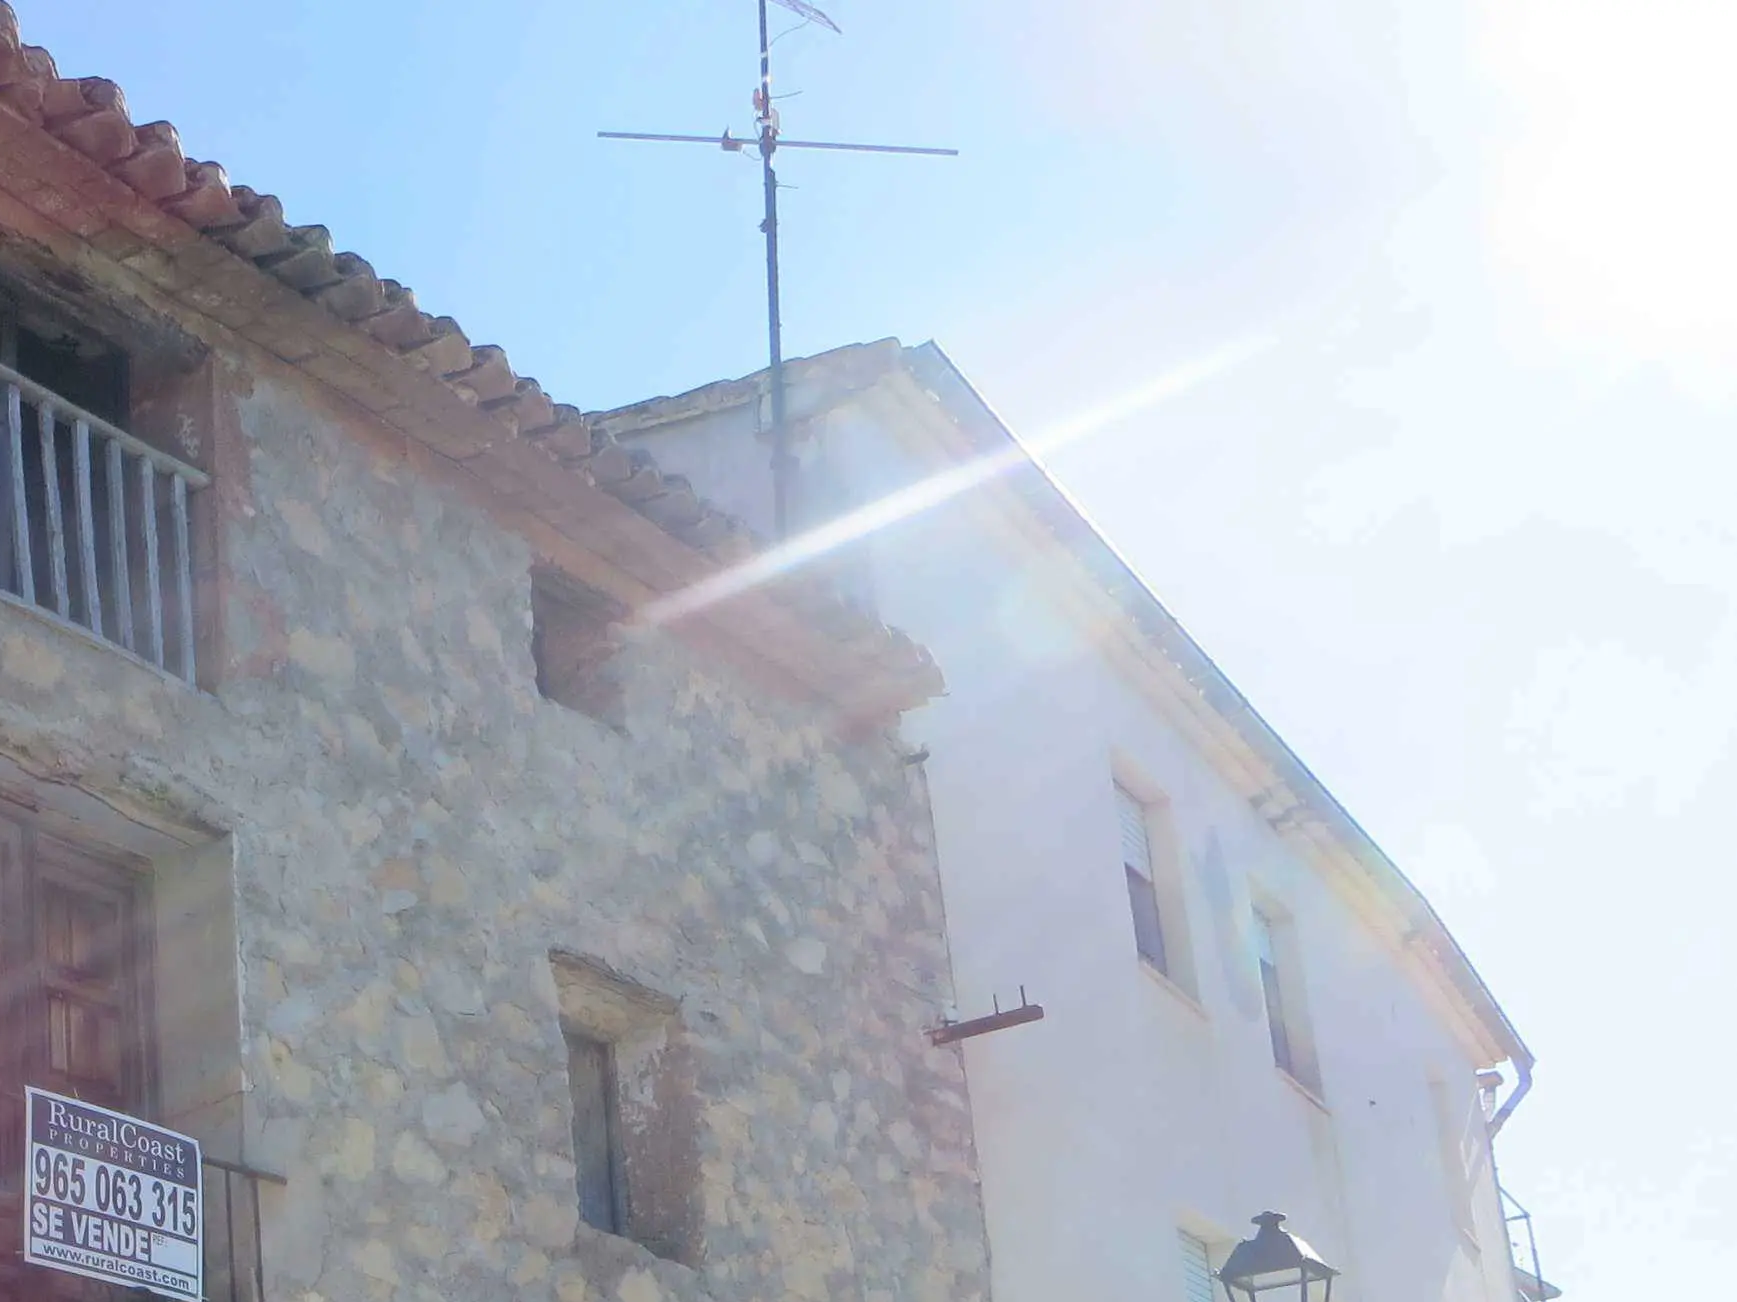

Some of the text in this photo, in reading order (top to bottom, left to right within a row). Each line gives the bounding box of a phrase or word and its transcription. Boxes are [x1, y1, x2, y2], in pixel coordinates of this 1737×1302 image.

[47, 1100, 185, 1164] RuralCoast
[49, 1128, 185, 1179] PROPERTIES
[35, 1148, 196, 1236] 965 063 315
[32, 1202, 149, 1262] SE VENDE
[43, 1244, 190, 1291] www.ruralcoast.com
